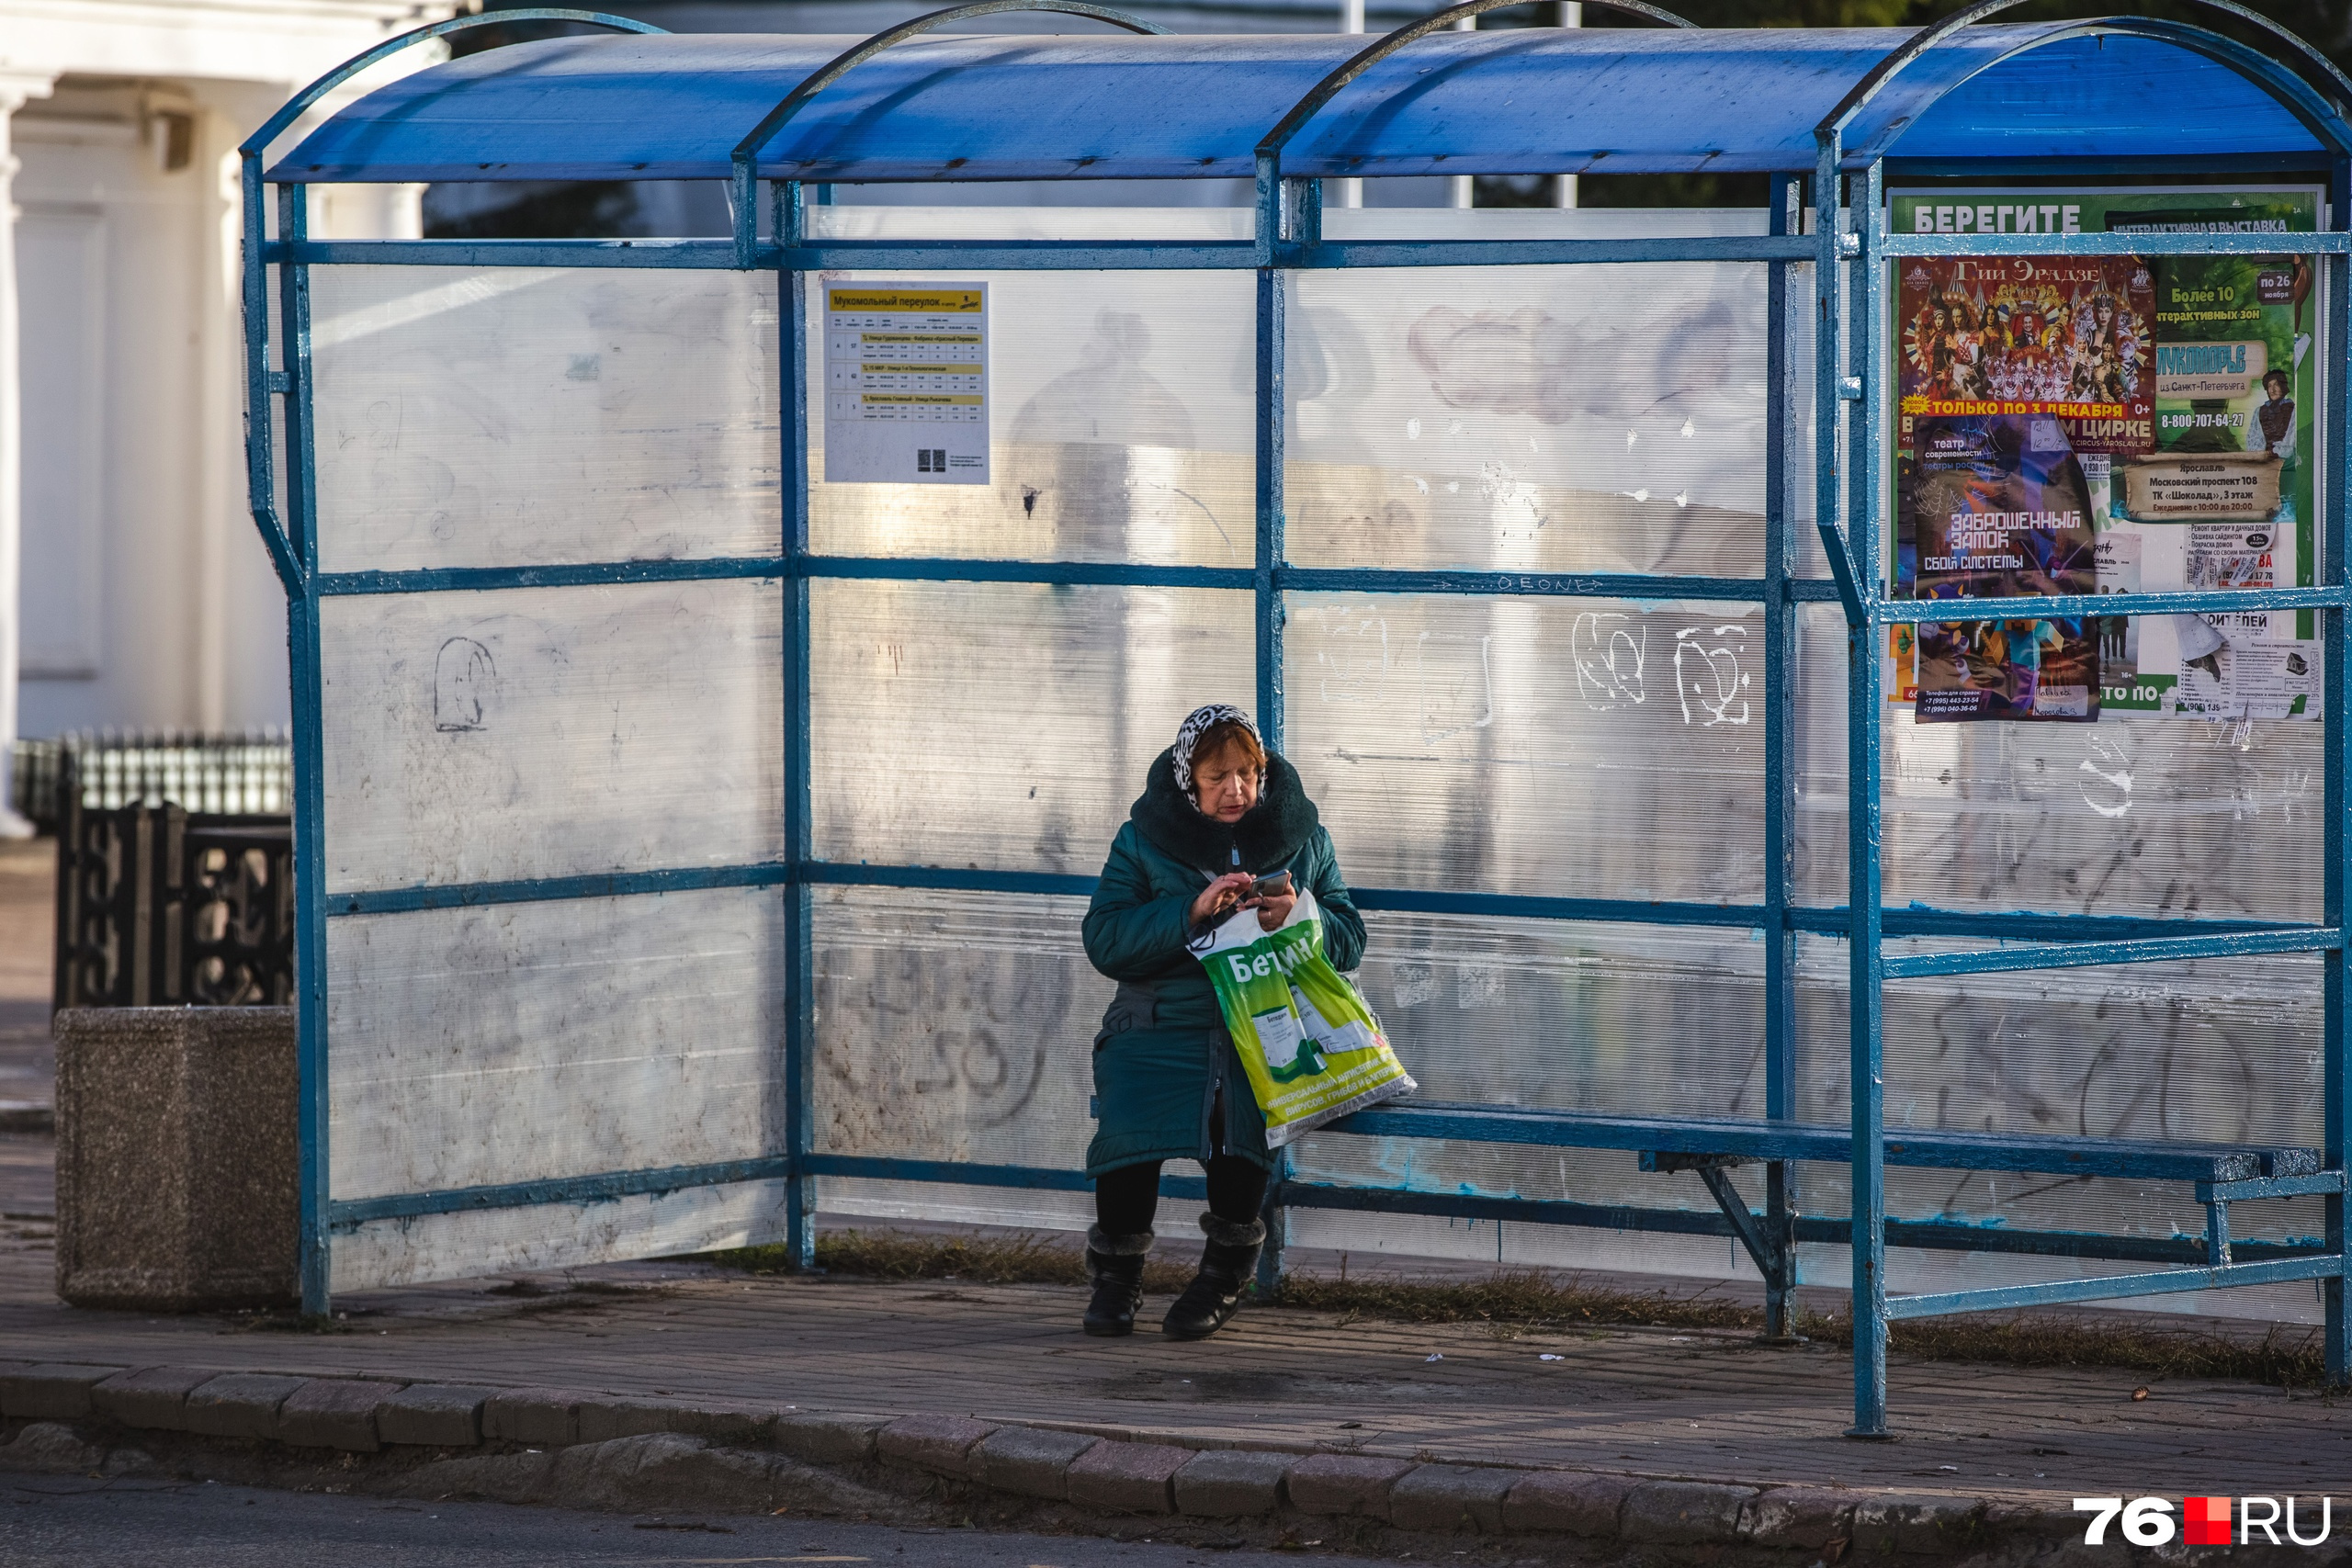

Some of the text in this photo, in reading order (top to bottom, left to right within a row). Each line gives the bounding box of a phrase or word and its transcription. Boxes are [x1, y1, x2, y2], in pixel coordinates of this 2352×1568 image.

[1915, 205, 2080, 232] БЕРЕГИТЕ
[2219, 220, 2287, 231] ВЫСТАВКА
[2261, 276, 2290, 288] по 26
[2172, 287, 2233, 303] Более 10
[834, 296, 898, 308] Мукомольный
[899, 298, 939, 308] переулок
[2240, 310, 2260, 320] зон
[2157, 345, 2245, 375] ЛУКОМОРЬЕ
[2172, 381, 2245, 391] Санкт-Петербурга
[1932, 402, 1997, 414] ТОЛЬКО
[2005, 402, 2027, 413] ПО
[2047, 403, 2122, 417] ДЕКАБРЯ
[2135, 404, 2150, 414] 0+
[2162, 413, 2244, 428] 8-800-707-64-27
[2083, 420, 2151, 439] ЦИРКЕ
[1935, 440, 1964, 450] театр
[1925, 450, 1982, 459] современности
[2180, 464, 2225, 473] Ярославль
[2150, 477, 2257, 488] Московский проспект 108
[2153, 491, 2163, 500] ТК
[2223, 491, 2229, 499] 3
[2231, 491, 2253, 500] этаж
[2154, 504, 2192, 513] Ежедневно
[1951, 511, 2080, 531] ЗАБРОШЕННЫЙ
[1925, 555, 2023, 570] СБОЙ СИСТЕМЫ
